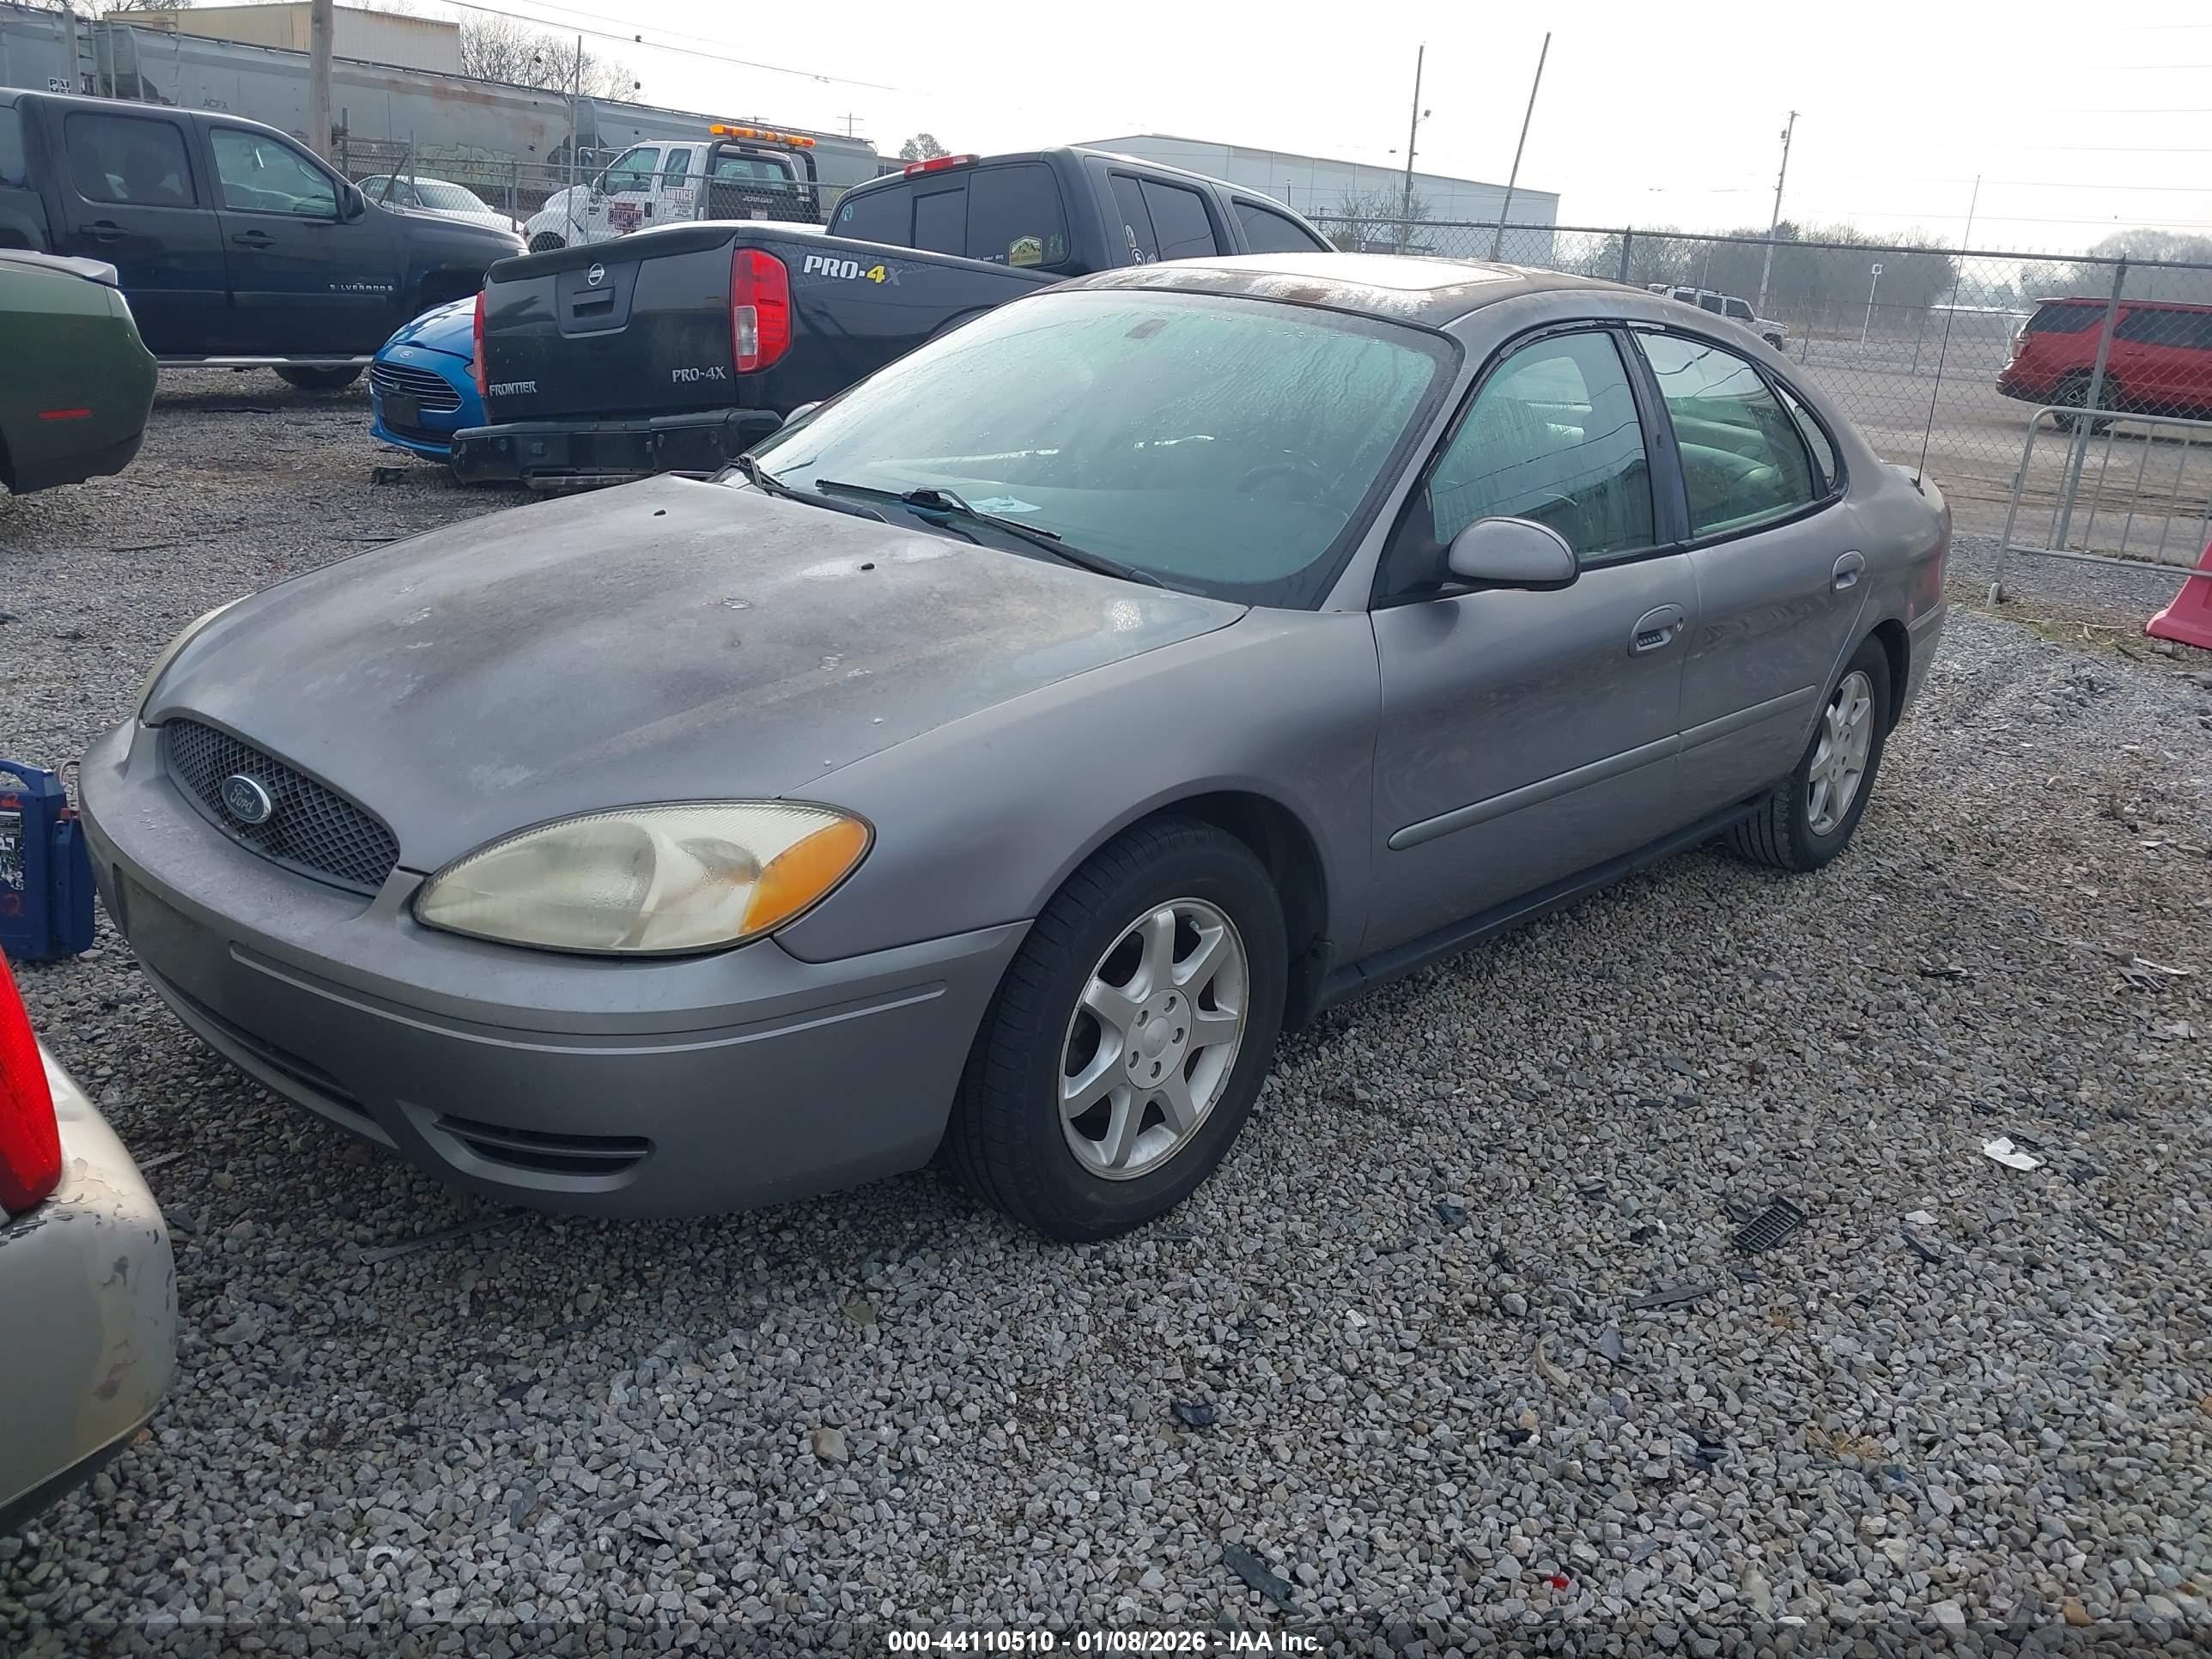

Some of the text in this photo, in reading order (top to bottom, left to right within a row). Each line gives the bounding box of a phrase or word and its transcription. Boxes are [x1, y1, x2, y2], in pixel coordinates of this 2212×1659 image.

[665, 188, 693, 201] NOTICE
[609, 210, 642, 223] BURCHAM
[803, 255, 903, 286] PRO-4X
[672, 366, 727, 383] PRO-4X
[489, 380, 538, 397] FRONTIER
[229, 783, 256, 813] Ford
